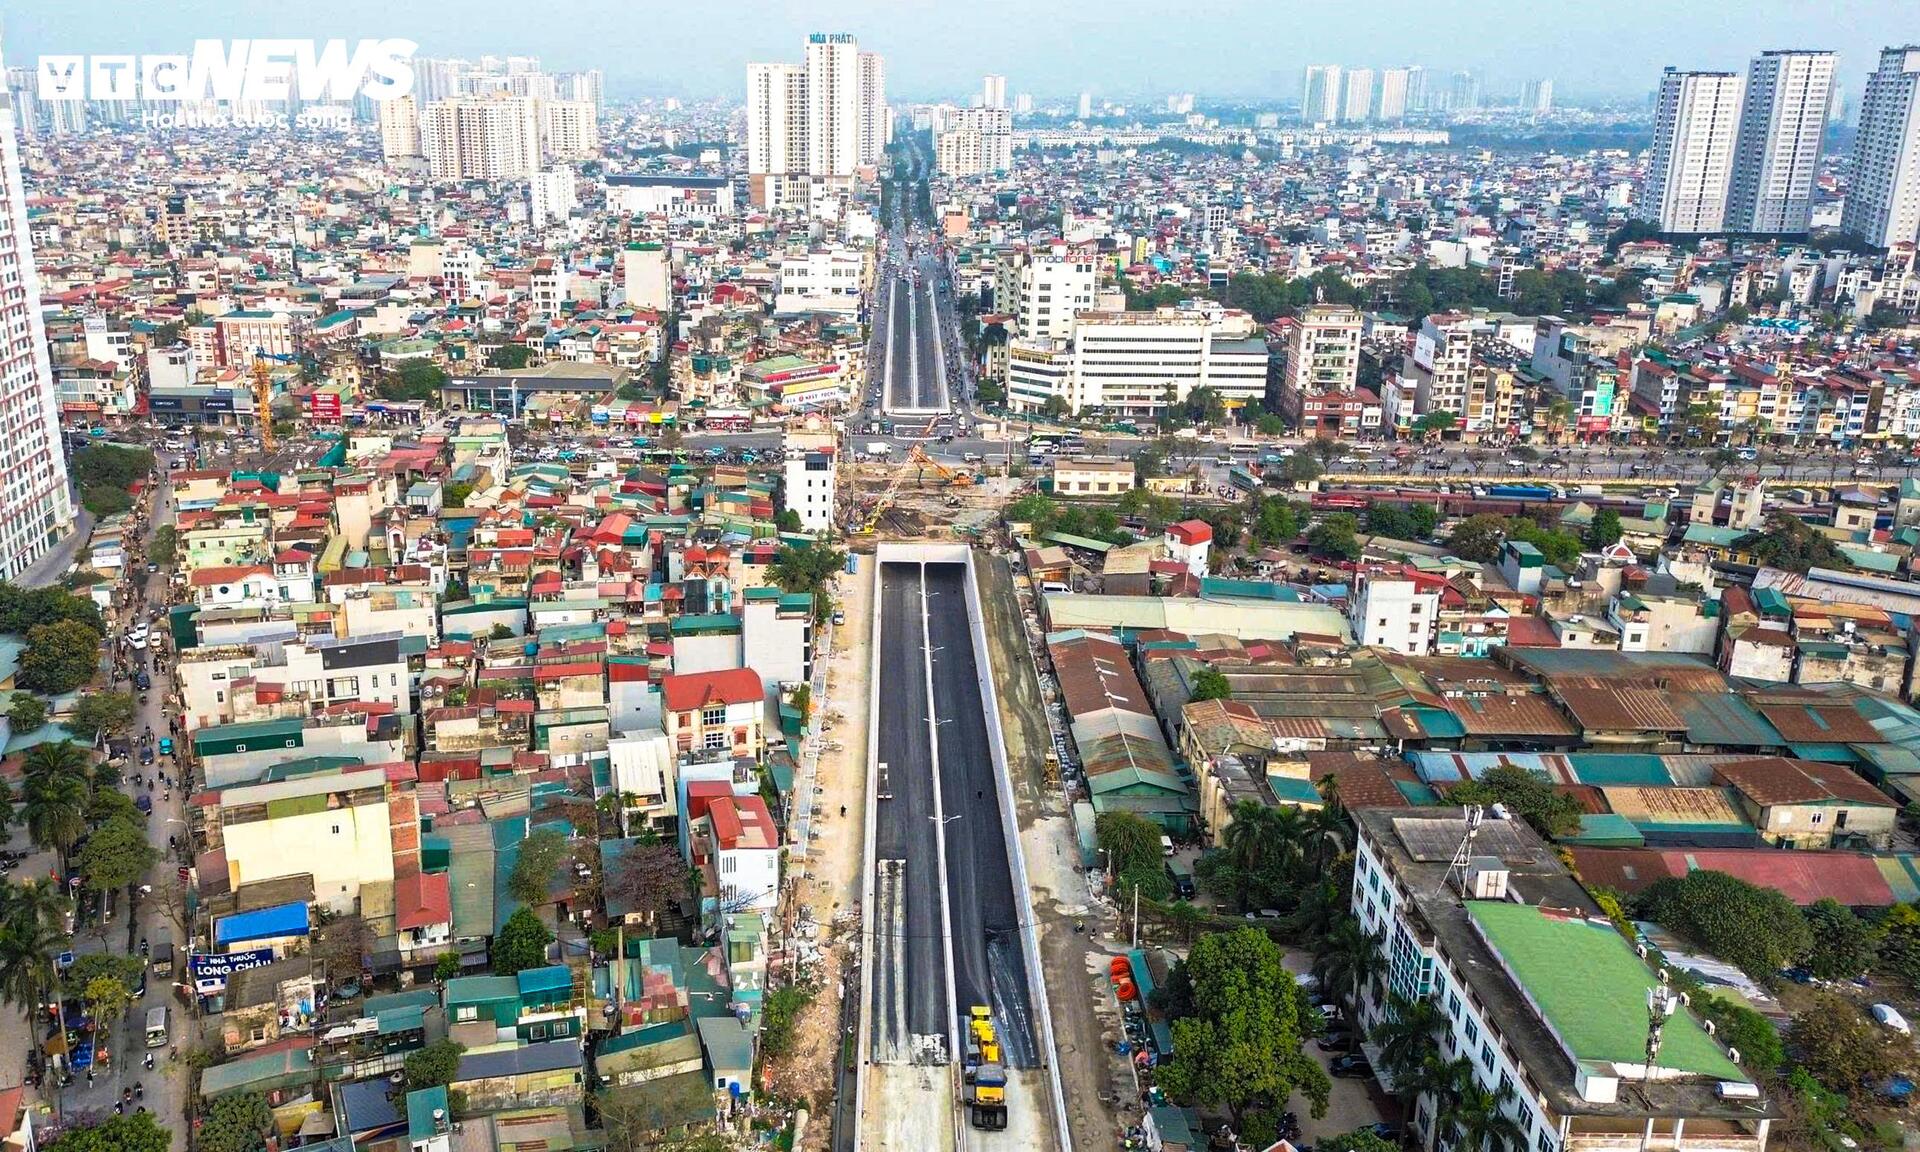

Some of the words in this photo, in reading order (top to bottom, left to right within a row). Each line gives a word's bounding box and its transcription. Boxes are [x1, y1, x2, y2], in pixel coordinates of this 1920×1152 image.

[810, 32, 826, 43] HÒA
[1033, 254, 1093, 263] mobifone
[209, 957, 226, 965] NHÀ
[229, 953, 256, 962] THUỐC
[197, 966, 231, 975] LONG
